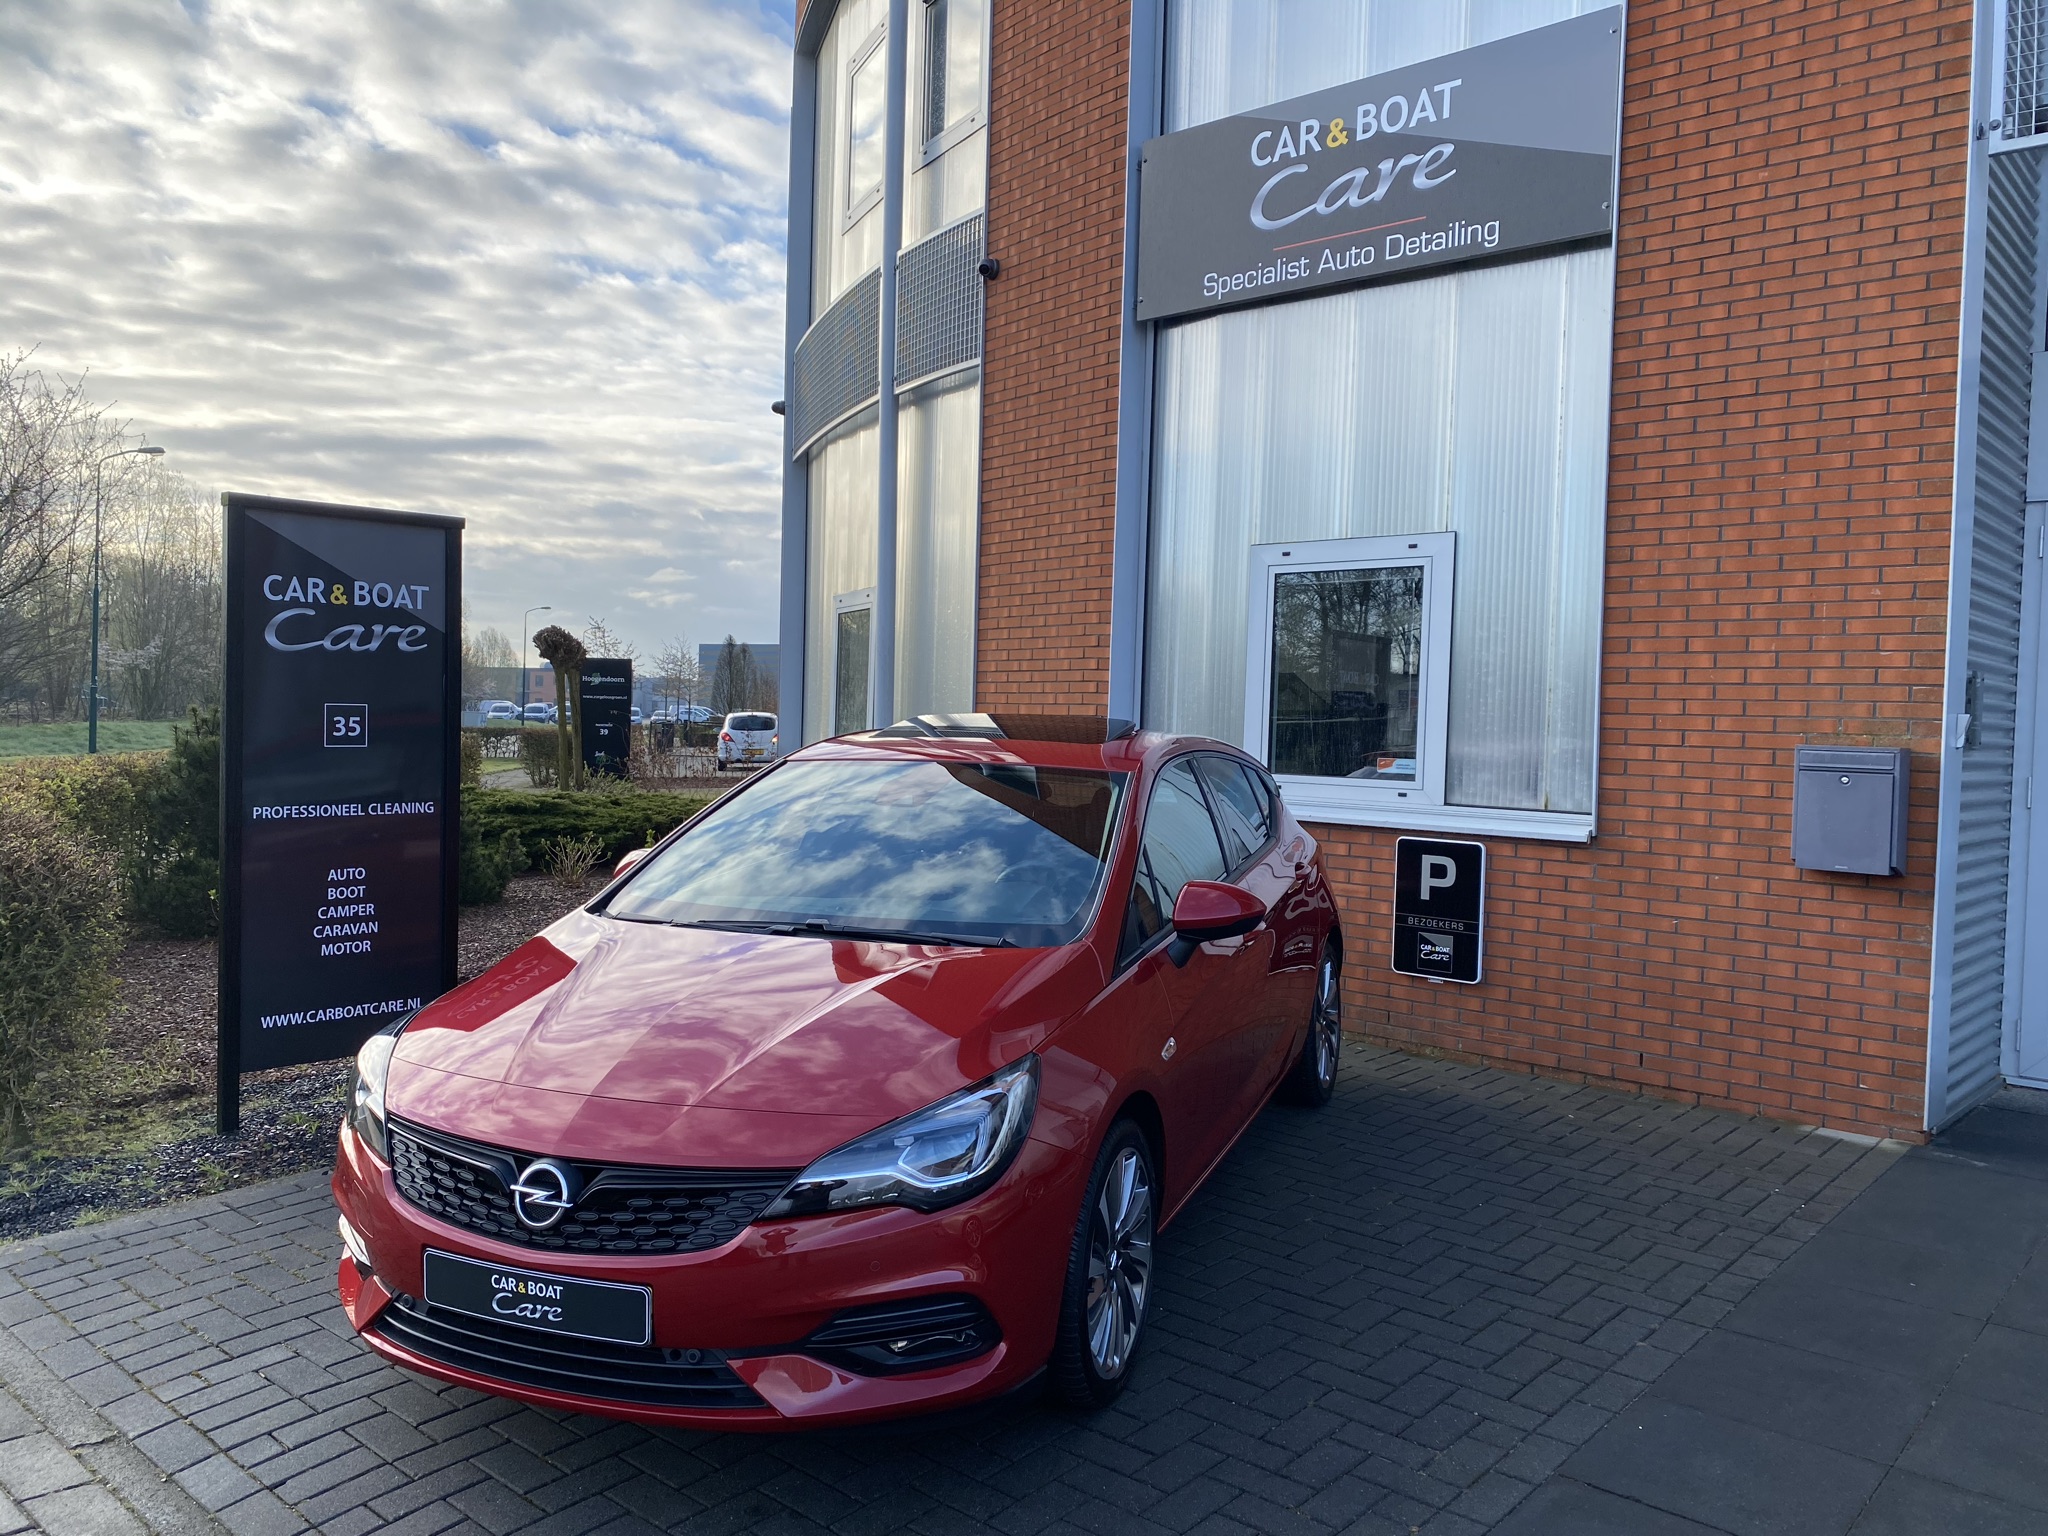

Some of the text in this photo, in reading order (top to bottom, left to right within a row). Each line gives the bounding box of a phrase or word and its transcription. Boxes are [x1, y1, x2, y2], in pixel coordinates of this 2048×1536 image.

[1250, 118, 1322, 167] CAR
[1355, 78, 1463, 142] BOAT
[1250, 142, 1457, 231] Care
[1203, 219, 1501, 300] Specialist Auto Detailing
[263, 574, 326, 604] CAR
[353, 580, 430, 610] BOAT
[264, 607, 428, 652] Care
[582, 675, 625, 683] Hoogendoorn
[332, 716, 361, 737] 35
[599, 728, 609, 736] 39
[252, 801, 435, 819] PROFESSIONEEL CLEANING
[327, 867, 366, 881] AUTO
[1420, 854, 1457, 900] P
[327, 886, 366, 900] BOOT
[317, 903, 375, 919] CAMPER
[313, 921, 379, 938] CARAVAN
[1407, 917, 1464, 931] BEZOEKERS
[320, 940, 371, 956] MOTOR
[1420, 950, 1450, 961] Care
[491, 1274, 517, 1292] CAR
[528, 1281, 563, 1299] BOAT
[492, 1292, 563, 1320] Care
